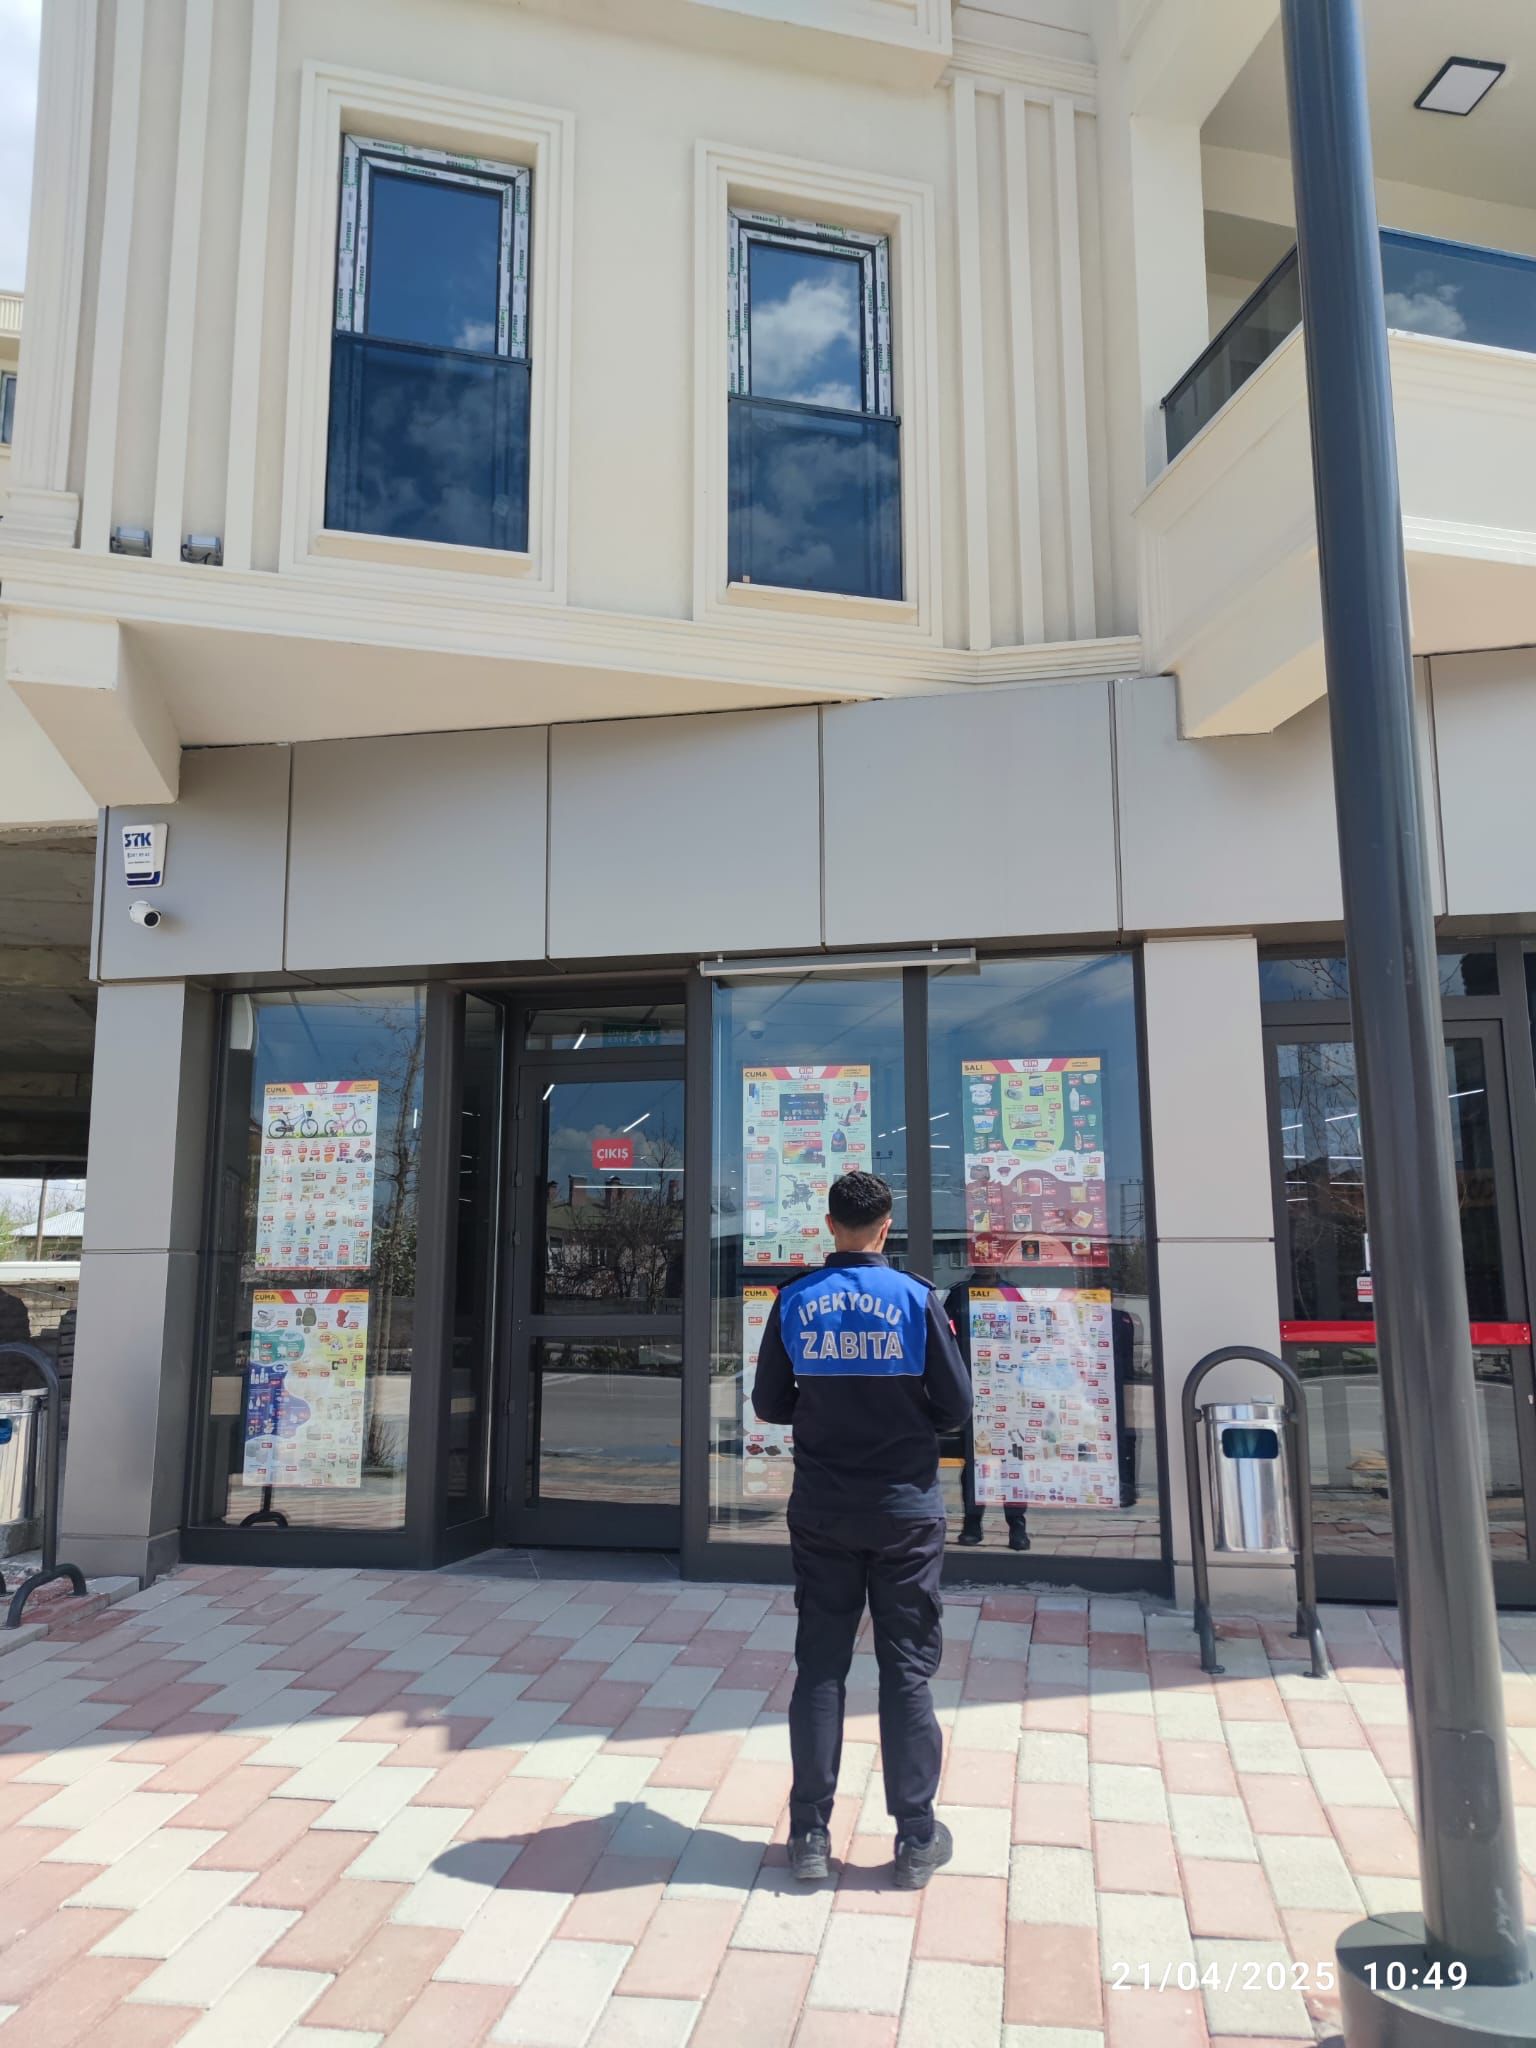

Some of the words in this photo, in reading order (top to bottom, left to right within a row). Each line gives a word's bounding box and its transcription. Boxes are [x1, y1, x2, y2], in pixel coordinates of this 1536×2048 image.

[596, 1148, 629, 1161] ÇIKIŞ
[797, 1292, 903, 1326] İPEKYOLU
[799, 1331, 904, 1360] ZABITA
